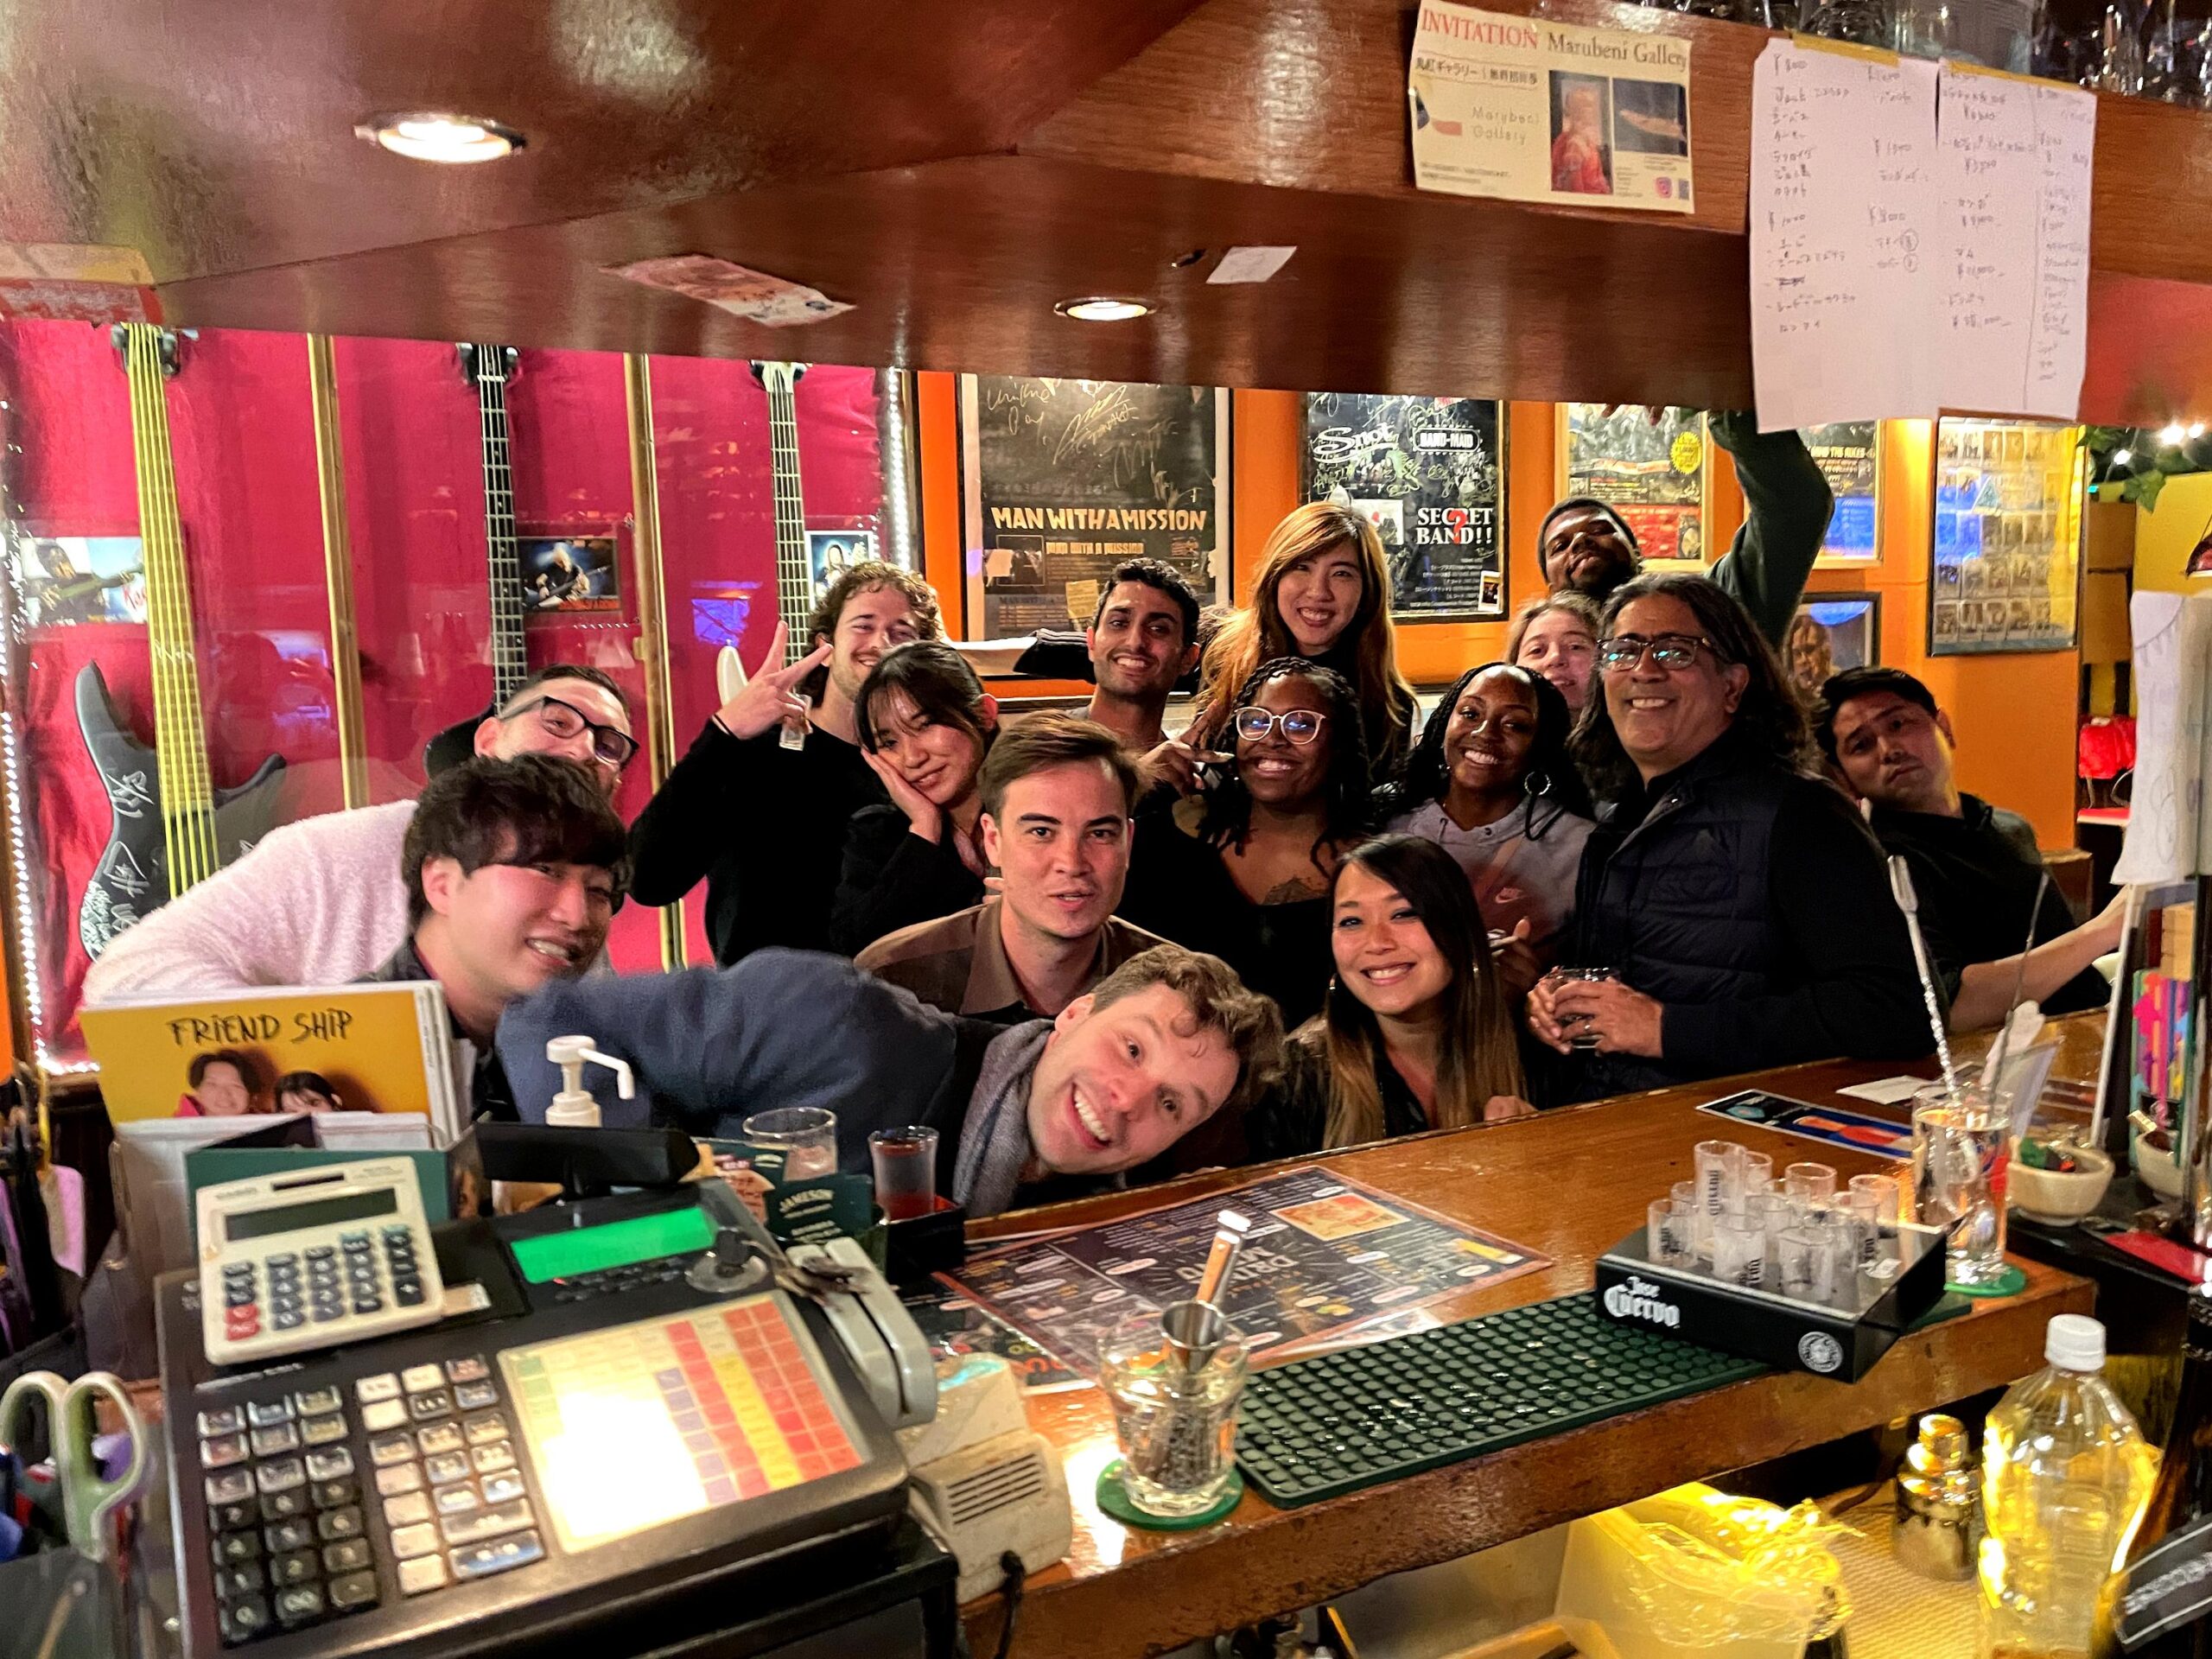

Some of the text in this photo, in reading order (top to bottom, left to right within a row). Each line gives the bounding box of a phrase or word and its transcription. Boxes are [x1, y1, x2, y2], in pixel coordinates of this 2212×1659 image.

[1422, 9, 1688, 72] INVITATION Marubeni Gallery
[991, 507, 1206, 531] MAN WITH A MISSION
[166, 1007, 353, 1047] FRIEND SHIP
